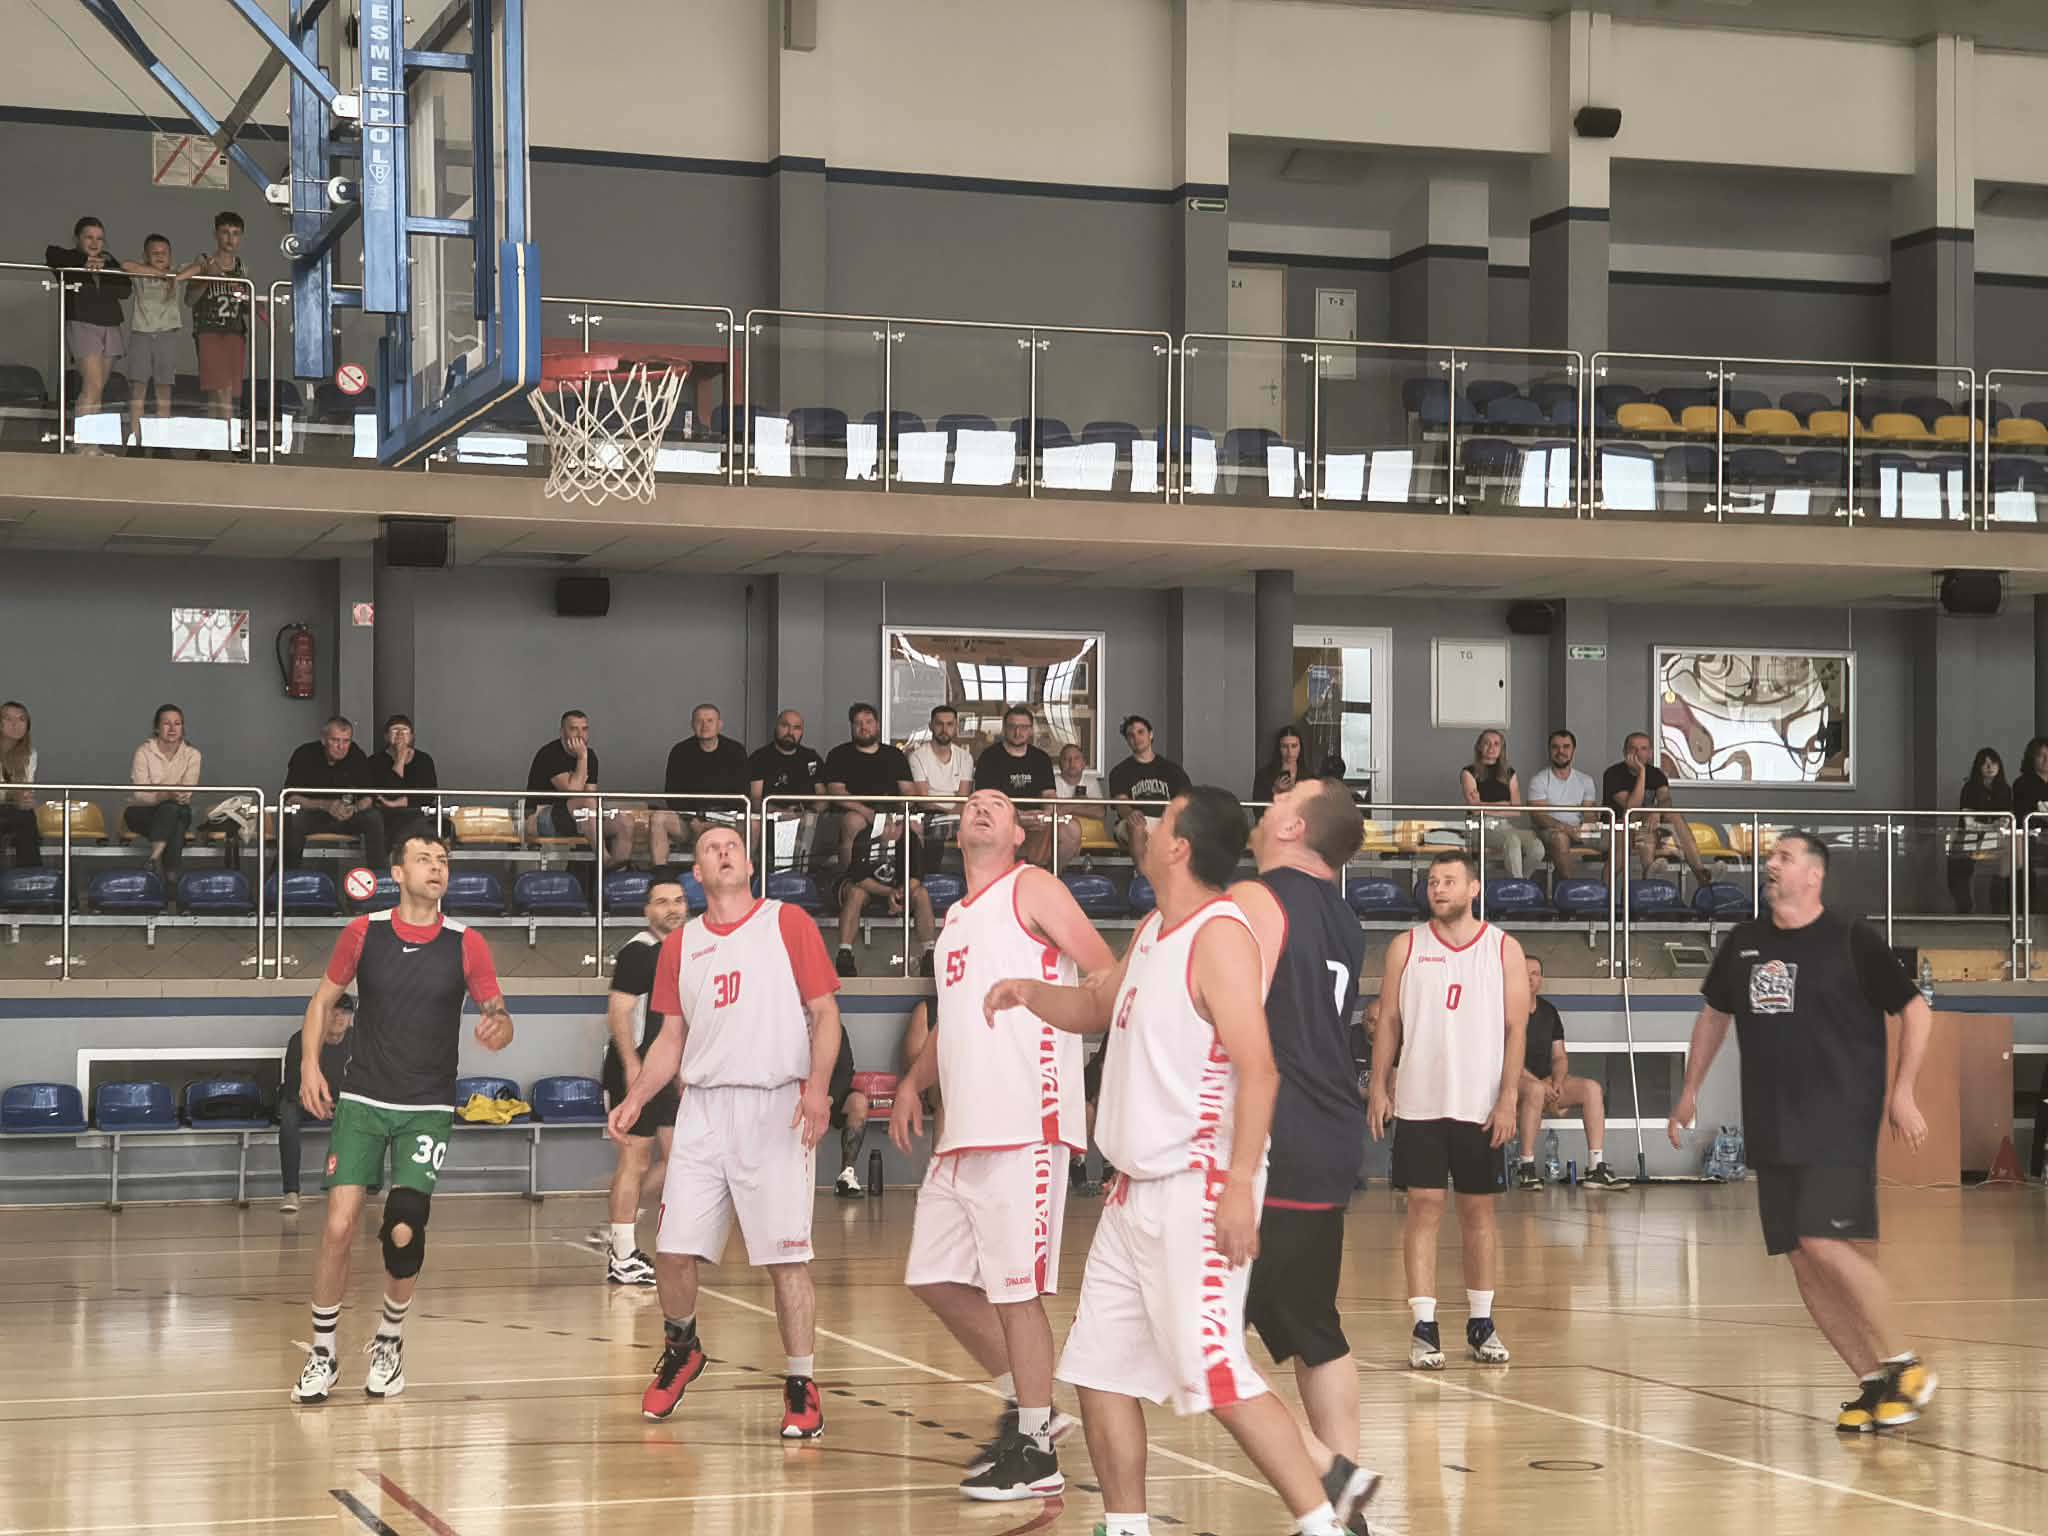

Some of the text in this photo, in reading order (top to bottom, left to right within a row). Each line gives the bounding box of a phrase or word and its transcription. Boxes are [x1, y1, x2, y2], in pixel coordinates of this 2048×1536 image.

[945, 945, 969, 987] 55
[713, 970, 741, 1009] 30
[1325, 960, 1350, 1017] 7
[1446, 984, 1462, 1010] 0
[412, 1134, 447, 1170] 30
